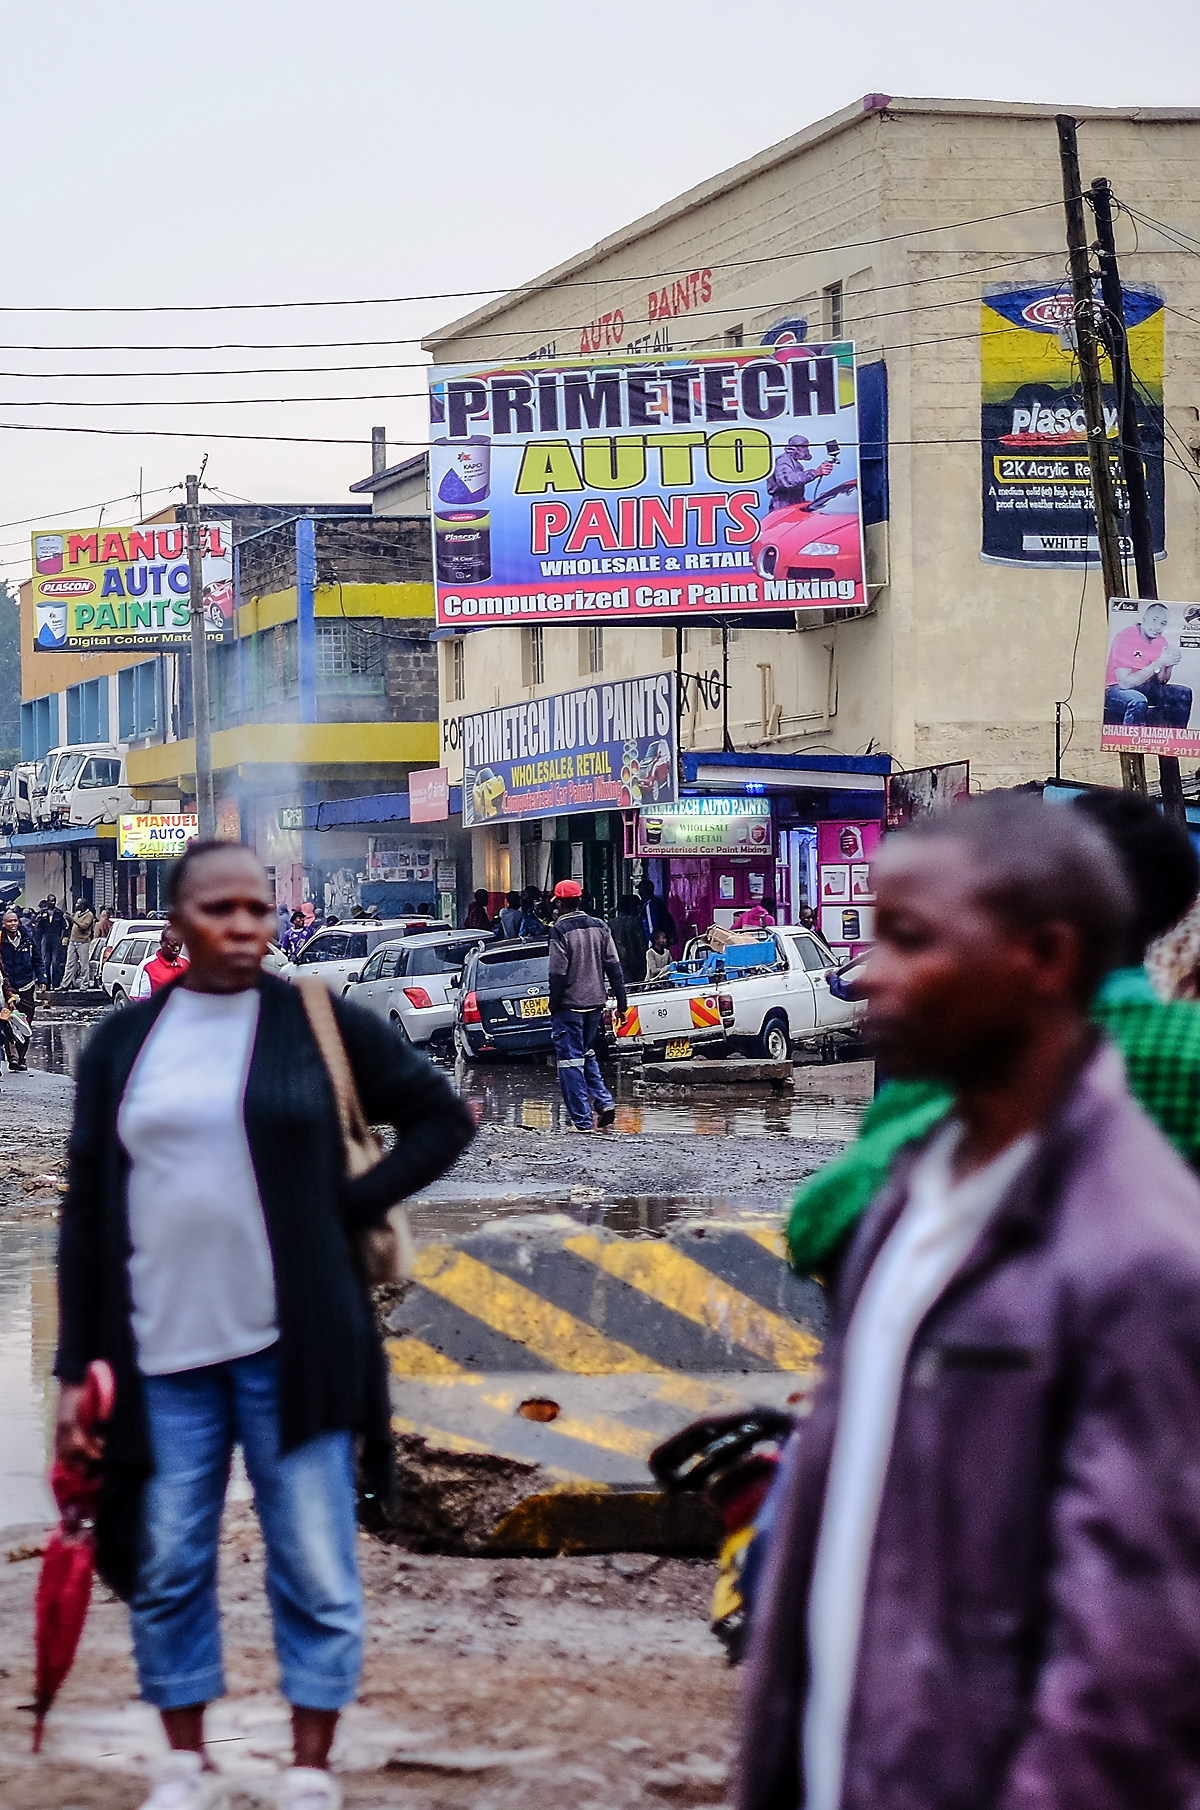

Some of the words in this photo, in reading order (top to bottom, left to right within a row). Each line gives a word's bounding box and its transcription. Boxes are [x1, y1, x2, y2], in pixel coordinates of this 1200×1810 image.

[580, 309, 625, 356] AUTO
[648, 269, 712, 325] PAINTS
[446, 357, 838, 437] PRIMETECH
[515, 428, 772, 495] AUTO
[1003, 462, 1025, 476] 2K
[1029, 461, 1070, 478] Acrylic
[531, 491, 760, 555] PAINTS
[1041, 538, 1088, 548] WHITE
[540, 556, 660, 577] WHOLESALE
[665, 555, 681, 571] &
[685, 551, 753, 569] RETAIL
[43, 583, 91, 592] PLASCON
[101, 563, 190, 597] AUTO
[444, 585, 632, 617] Computerized
[635, 585, 681, 608] Car
[693, 579, 758, 606] Paint
[764, 576, 855, 602] Mixing
[75, 598, 191, 631] PAINTS
[69, 636, 111, 648] Digital
[114, 636, 159, 645] Colour
[464, 699, 550, 766] PRIMETECH
[554, 688, 598, 750] AUTO
[603, 675, 670, 742] PAINTS
[1102, 725, 1139, 737] CHARLES
[1141, 726, 1173, 739] NJAGUA
[1173, 748, 1200, 756] 2017
[577, 751, 611, 775] RETAIL
[555, 781, 567, 806] Car
[568, 779, 593, 804] Paints
[594, 774, 622, 806] Mixing
[701, 799, 729, 815] AUTO
[732, 798, 769, 814] PAINTS
[137, 815, 197, 827] MANUEL
[150, 828, 185, 839] AUTO
[139, 841, 185, 851] PAINTS
[643, 846, 698, 854] Computerised
[717, 845, 738, 853] Paint
[740, 846, 767, 854] Mixing
